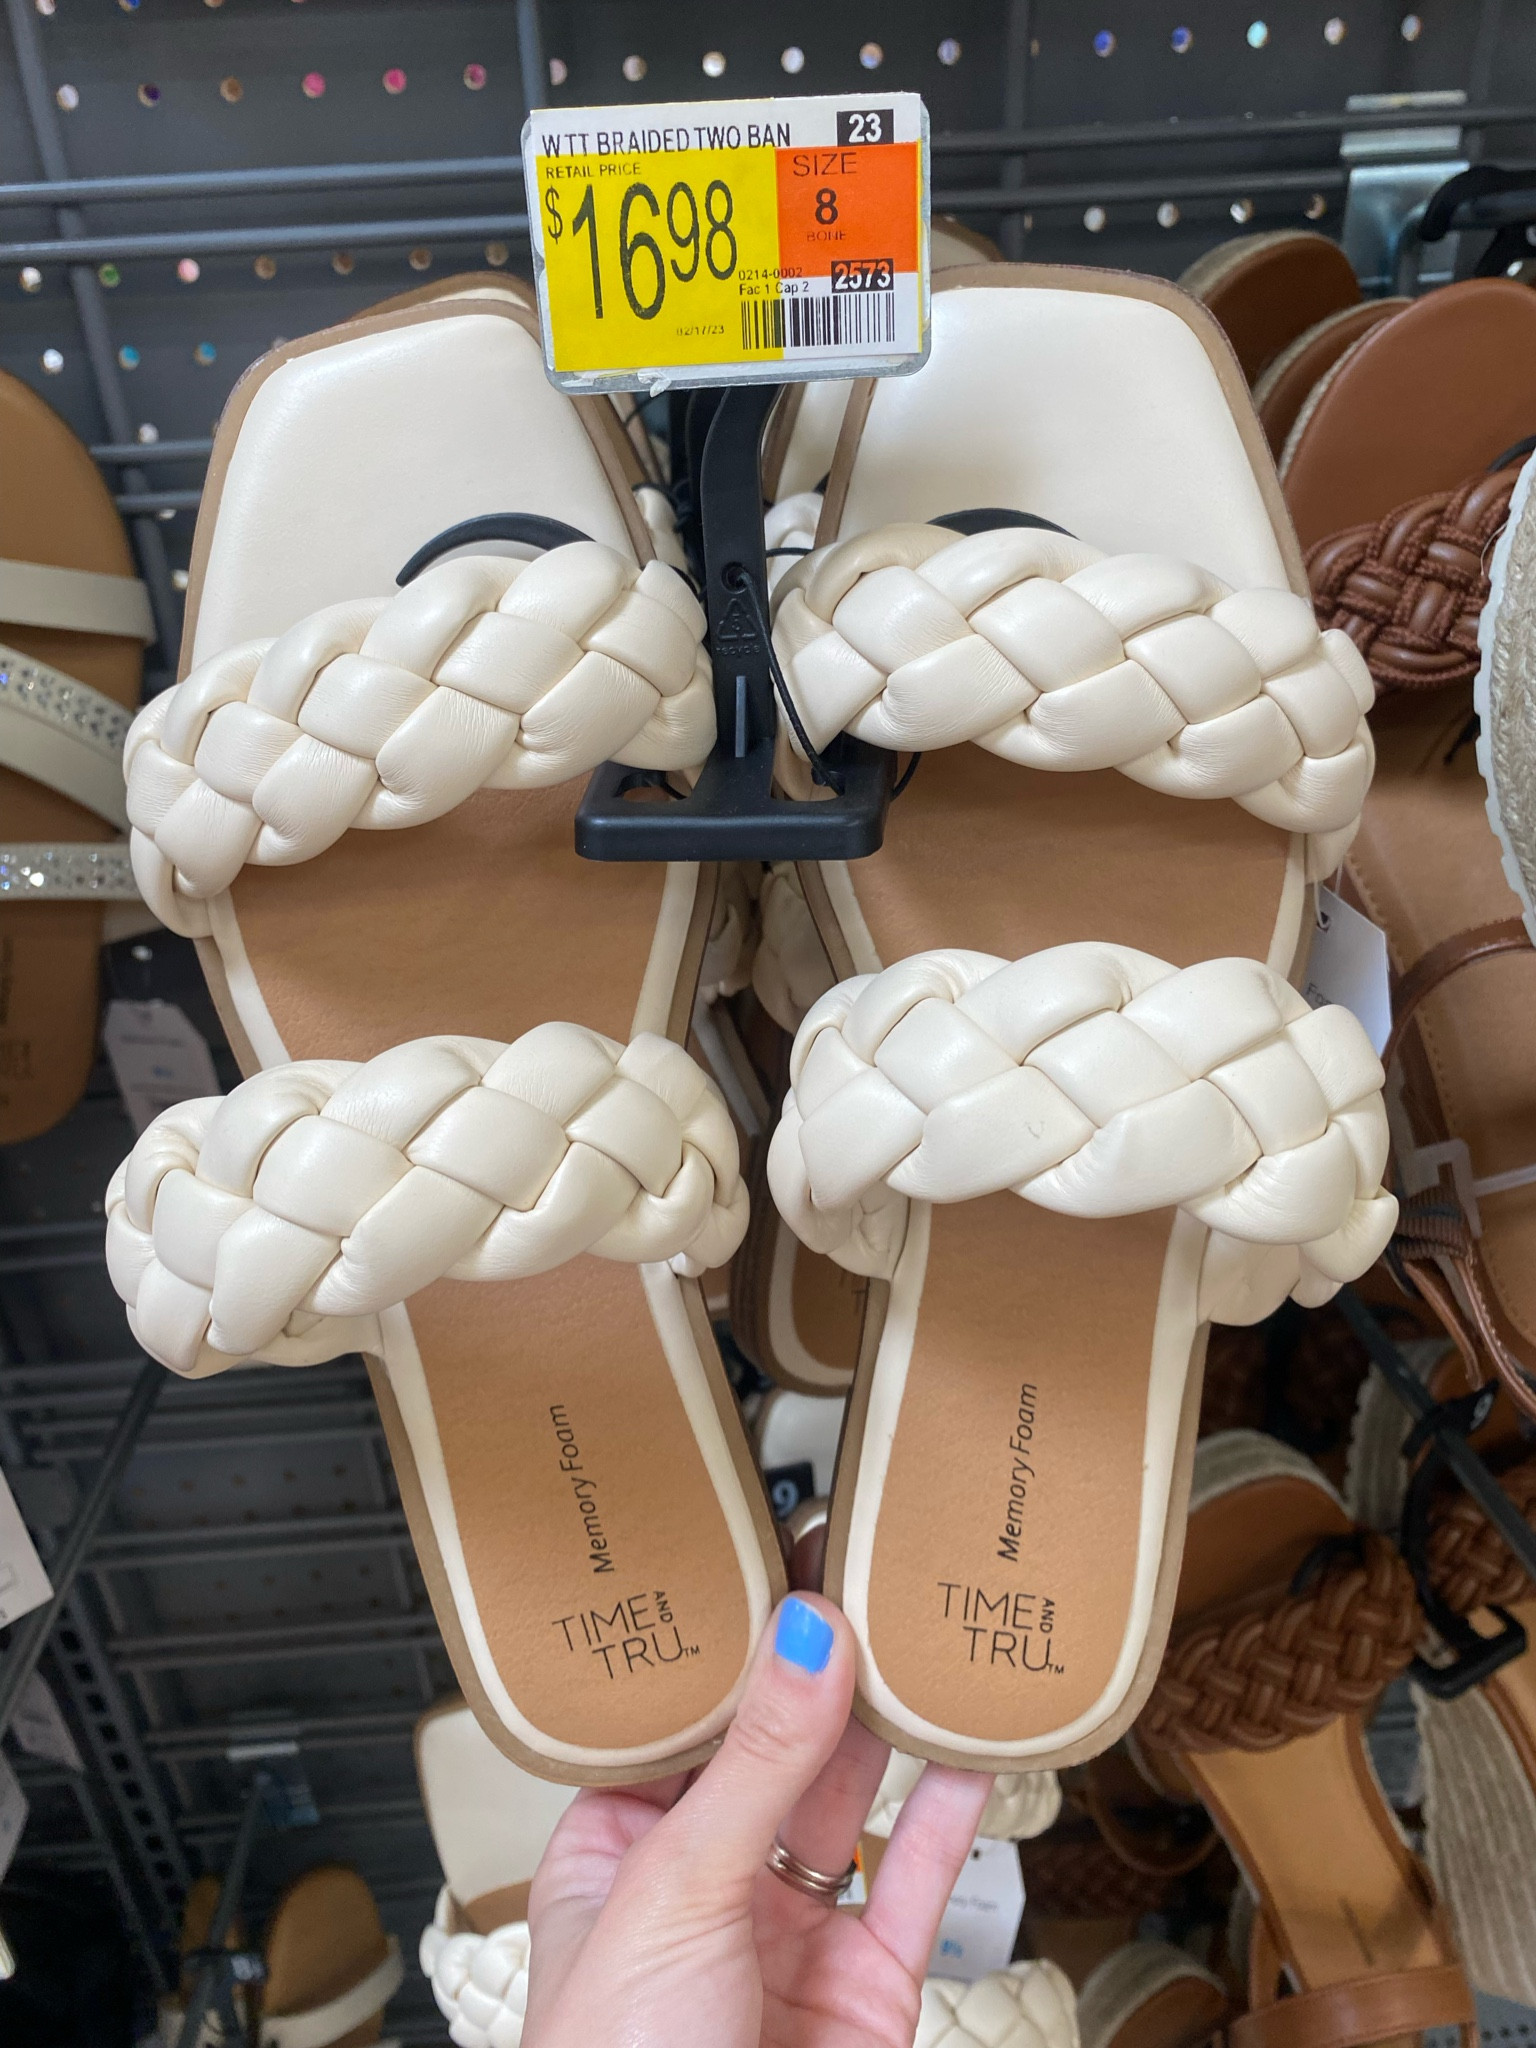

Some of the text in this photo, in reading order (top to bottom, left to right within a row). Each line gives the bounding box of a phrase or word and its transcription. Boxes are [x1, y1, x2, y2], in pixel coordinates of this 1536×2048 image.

[597, 128, 690, 156] BRAIDED
[694, 125, 741, 150] TWO
[748, 123, 791, 148] BAN
[848, 112, 882, 143] 23
[546, 162, 641, 179] RETAIL PRICE
[793, 152, 857, 177] SIZE
[815, 187, 838, 225] 8
[807, 230, 847, 241] BONE
[738, 267, 803, 281] 0214-0002
[739, 281, 810, 296] Fac 1 Cap 2
[834, 261, 891, 291] 2573
[997, 1382, 1037, 1562] Memory Foam
[550, 1404, 615, 1574] Memory Foam
[552, 1593, 656, 1651] TIME
[653, 1589, 674, 1624] AND
[937, 1582, 1036, 1631] TIME
[1040, 1597, 1055, 1634] AND
